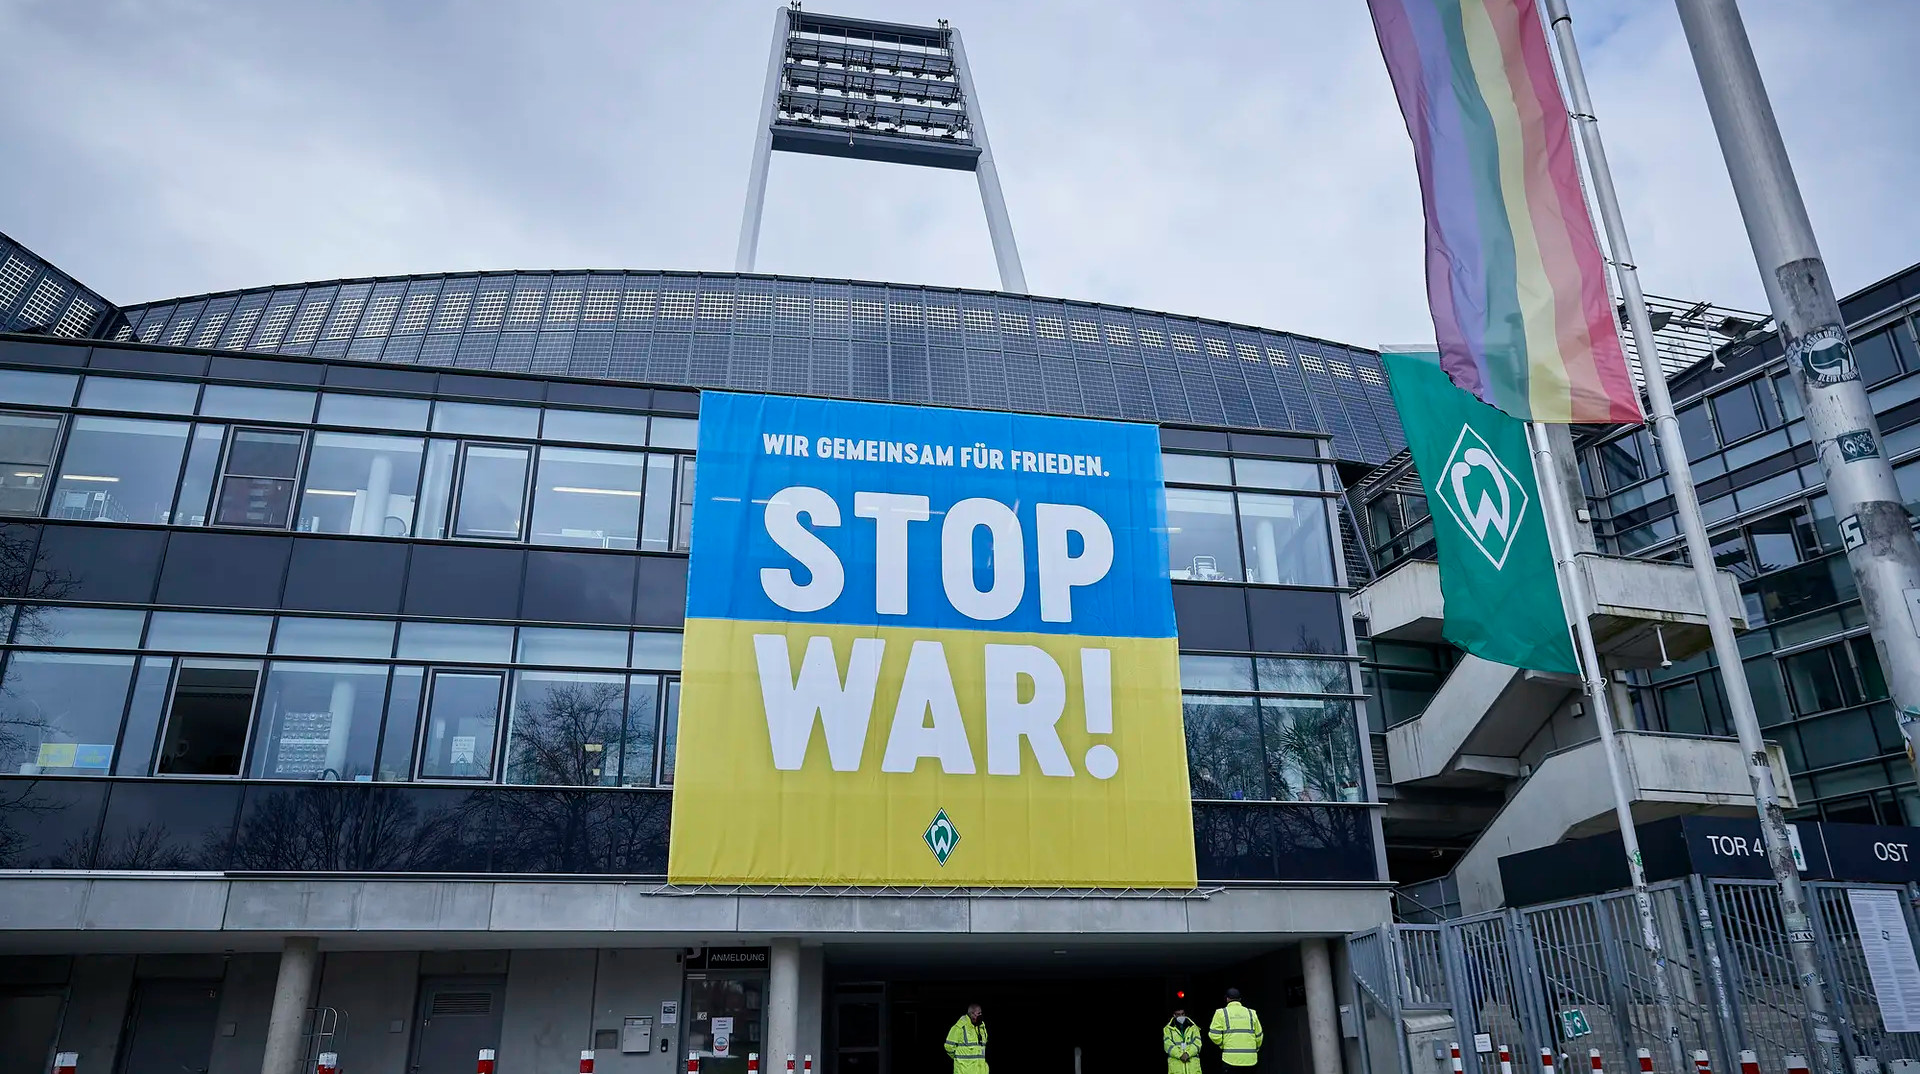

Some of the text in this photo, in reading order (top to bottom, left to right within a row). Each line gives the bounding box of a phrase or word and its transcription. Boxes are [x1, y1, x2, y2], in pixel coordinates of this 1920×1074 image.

[763, 433, 1110, 477] WIR GEMEINSAM FÜR FRIEDEN.
[760, 486, 1114, 622] STOP
[753, 634, 1119, 779] WAR!
[1707, 835, 1765, 857] TOR 4
[1874, 842, 1909, 862] OST
[711, 953, 765, 962] ANMELDUNG
